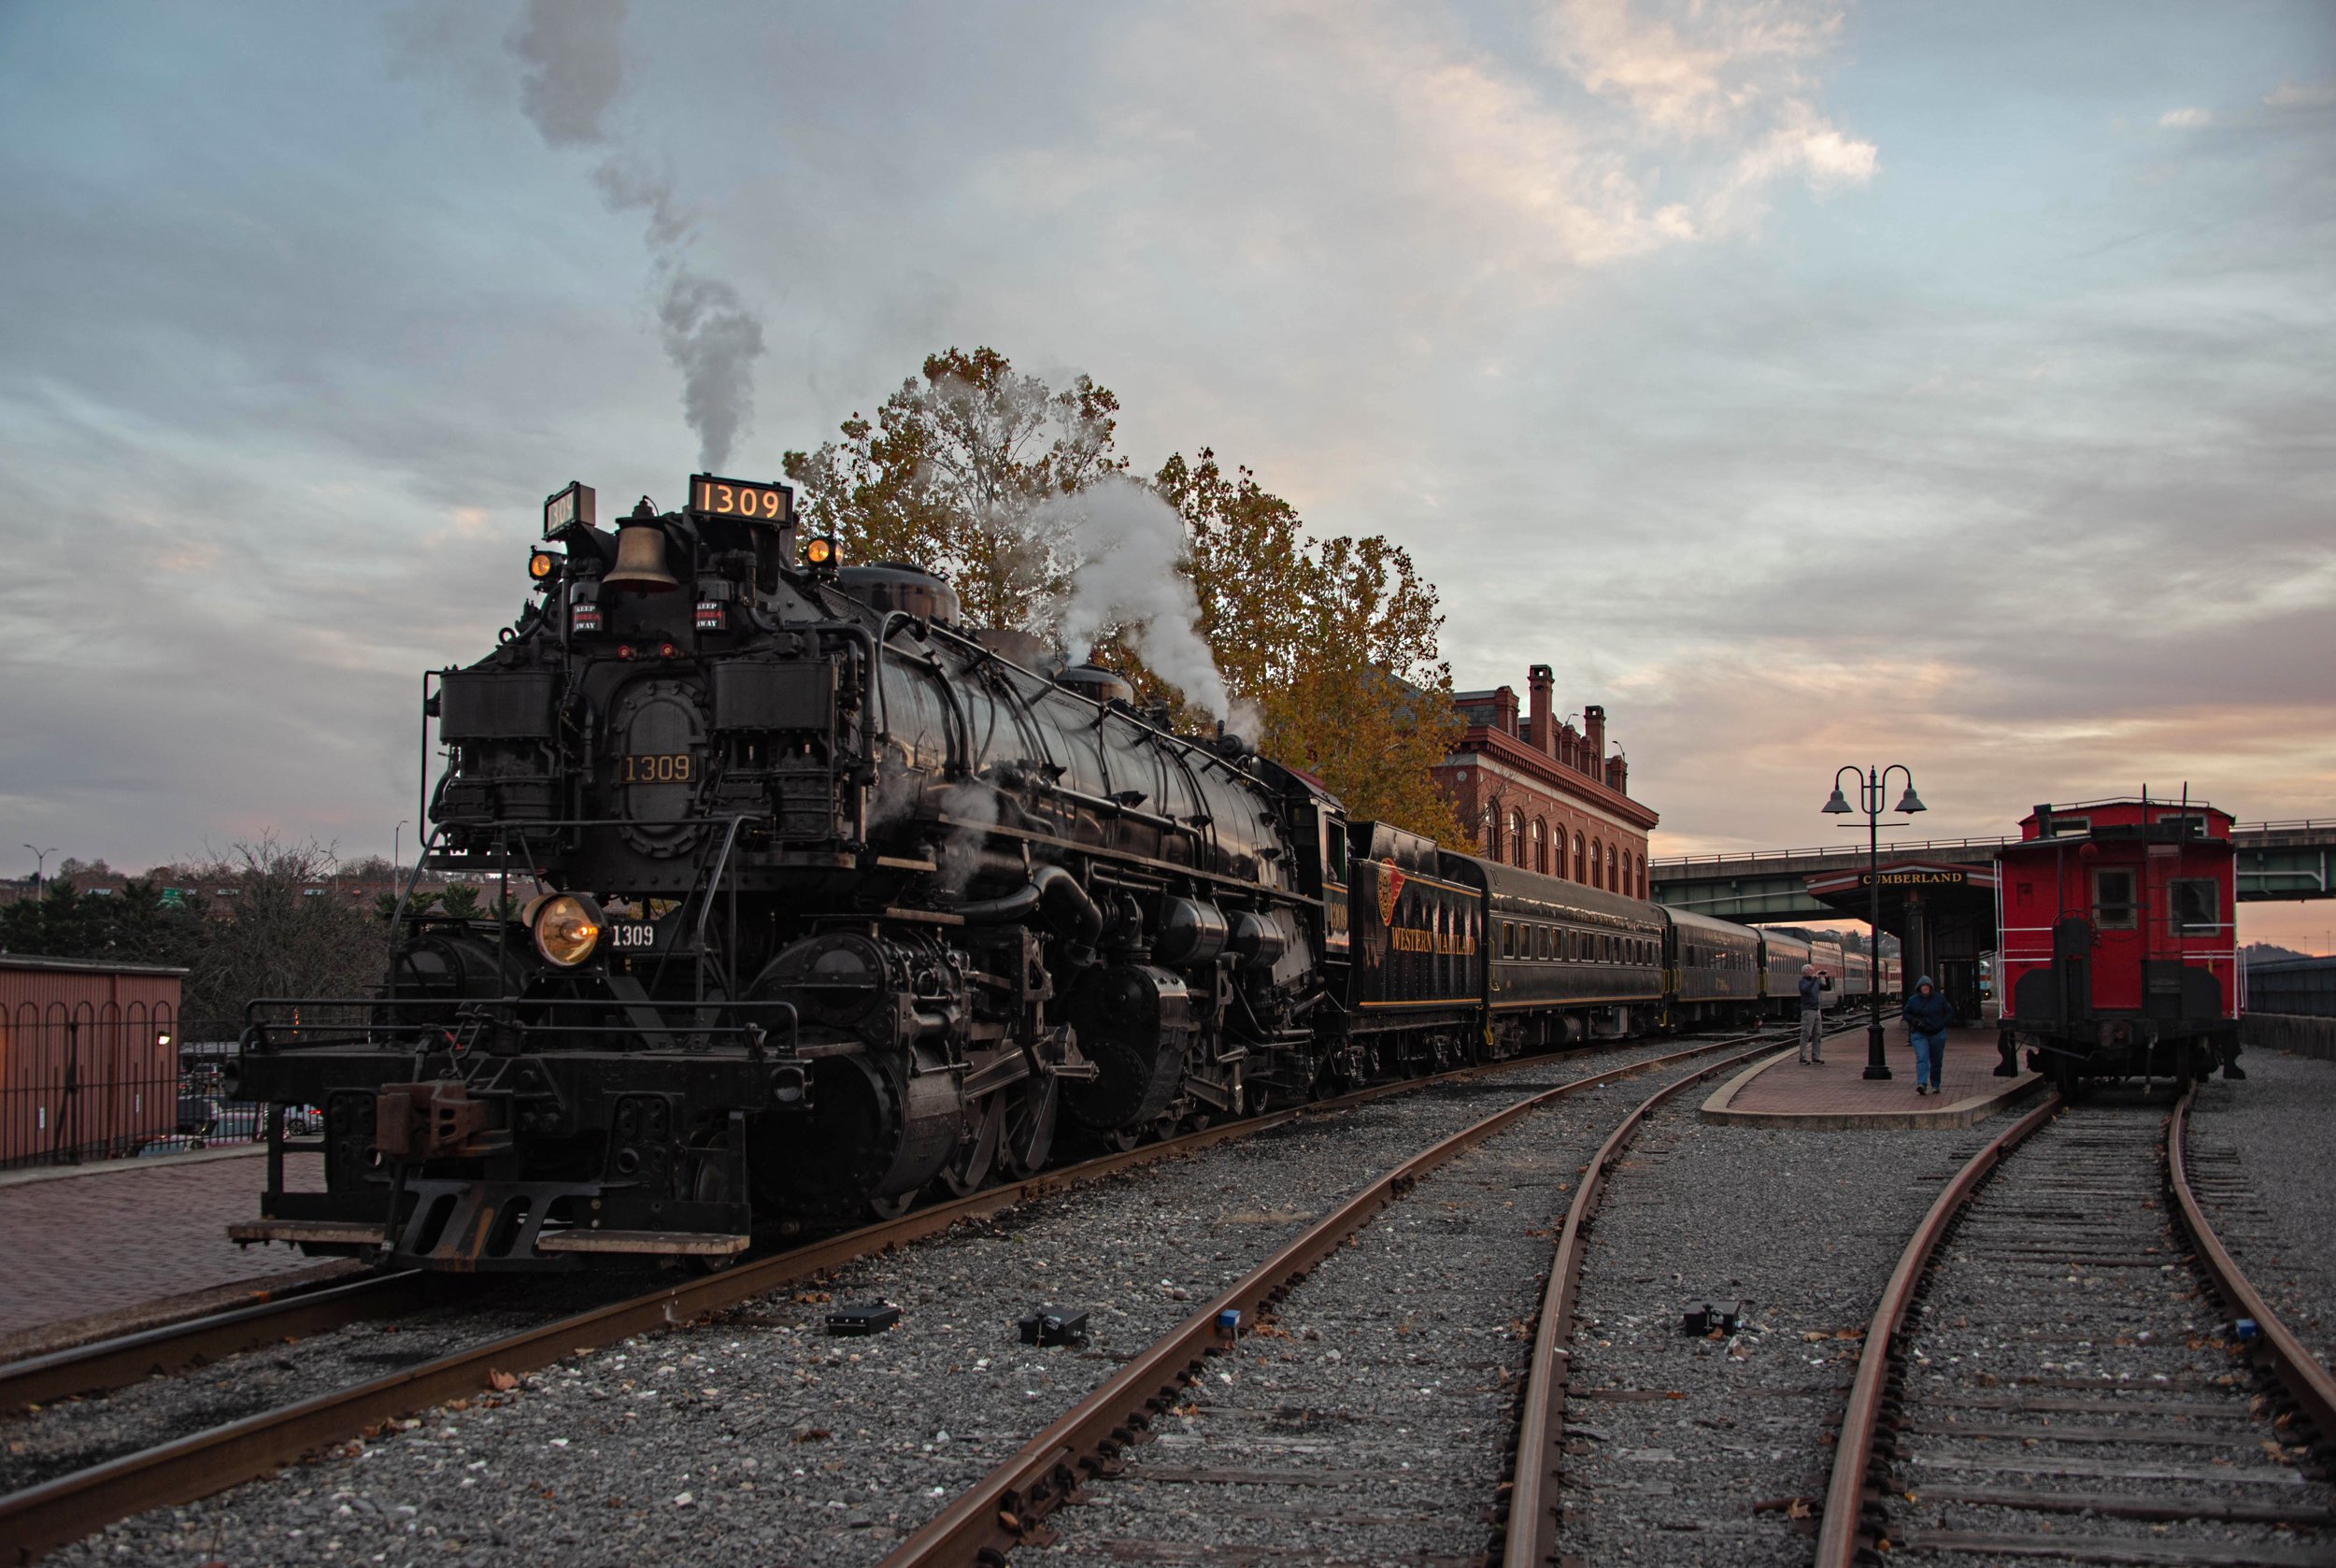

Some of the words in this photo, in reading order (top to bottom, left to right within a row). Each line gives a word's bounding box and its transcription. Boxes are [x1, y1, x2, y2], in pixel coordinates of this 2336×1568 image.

[704, 482, 779, 519] 1309
[576, 621, 595, 630] AWAY
[626, 755, 690, 782] 1309
[1330, 901, 1347, 931] 1309
[613, 925, 654, 947] 1309
[1391, 926, 1433, 953] WESTERN
